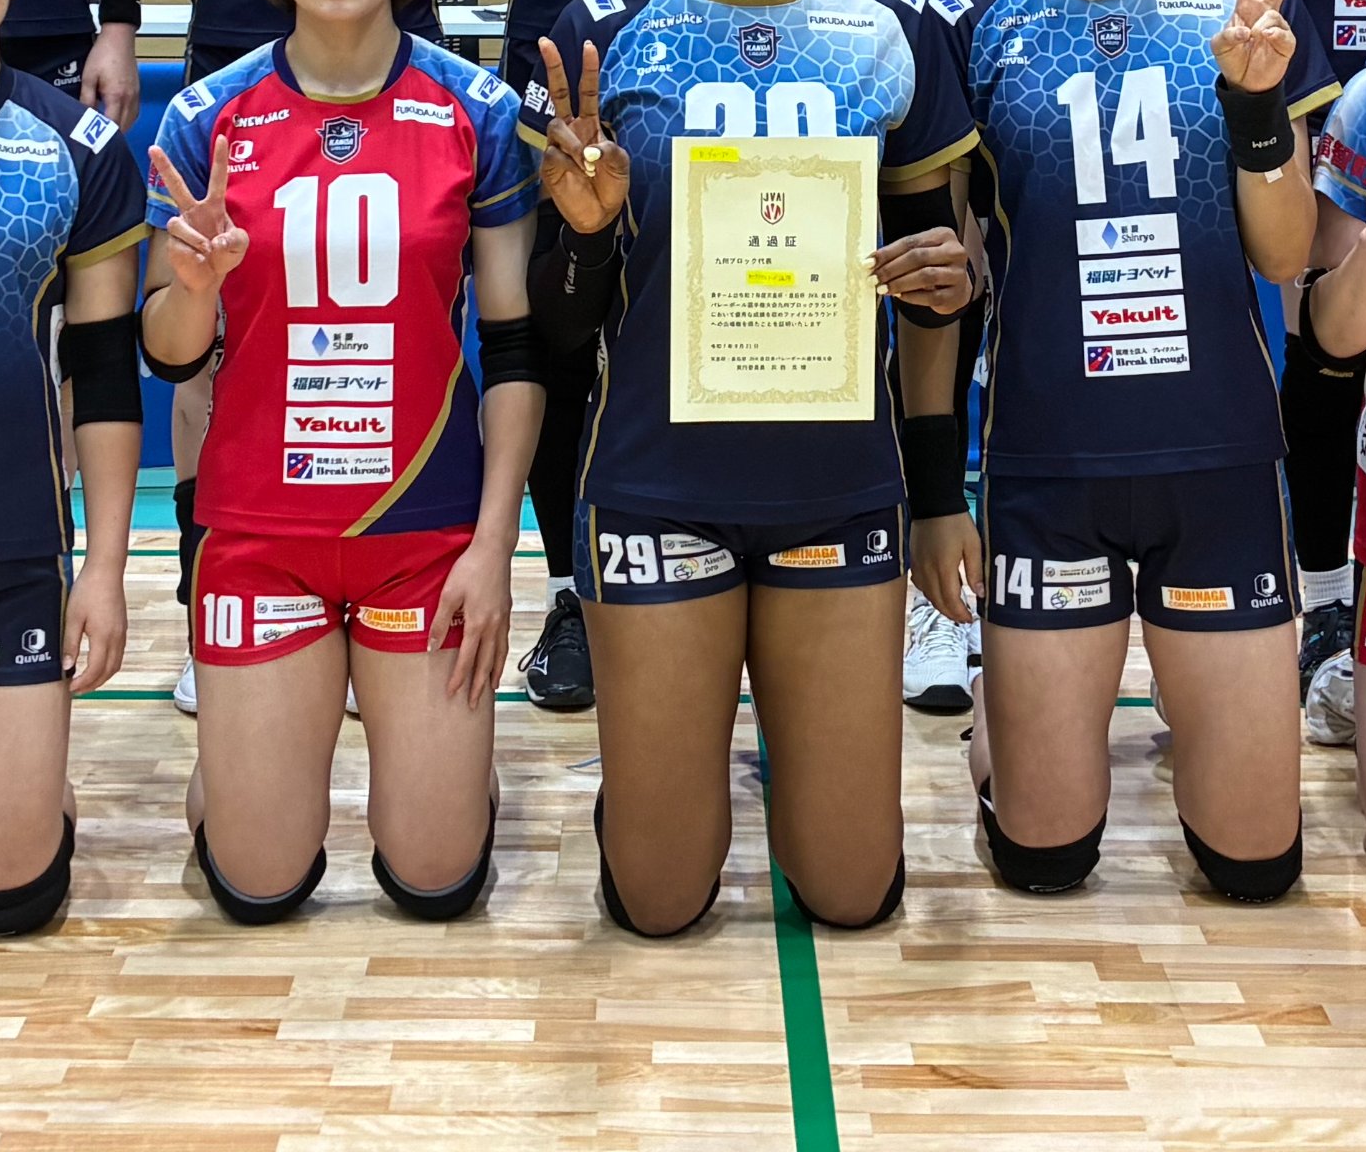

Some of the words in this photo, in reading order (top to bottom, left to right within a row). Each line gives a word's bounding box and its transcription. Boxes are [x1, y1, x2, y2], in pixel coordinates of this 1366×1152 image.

[676, 14, 704, 25] JACK
[1034, 8, 1058, 20] JACK
[1057, 66, 1180, 205] 14
[763, 192, 783, 202] JVA
[273, 172, 400, 309] 10
[1121, 232, 1155, 243] Shinryo
[1086, 265, 1176, 284] 福岡トヨペット
[1090, 306, 1179, 325] Yakult
[333, 341, 368, 352] Shinryo
[1116, 355, 1148, 367] Break
[1150, 353, 1187, 366] through
[293, 376, 388, 391] 福岡トヨペット
[293, 416, 386, 433] Yakult
[316, 466, 348, 476] Break
[350, 464, 390, 478] through
[599, 532, 659, 584] 29
[994, 554, 1034, 609] 14
[1168, 589, 1227, 603] TOMINAGA
[203, 593, 243, 648] 10
